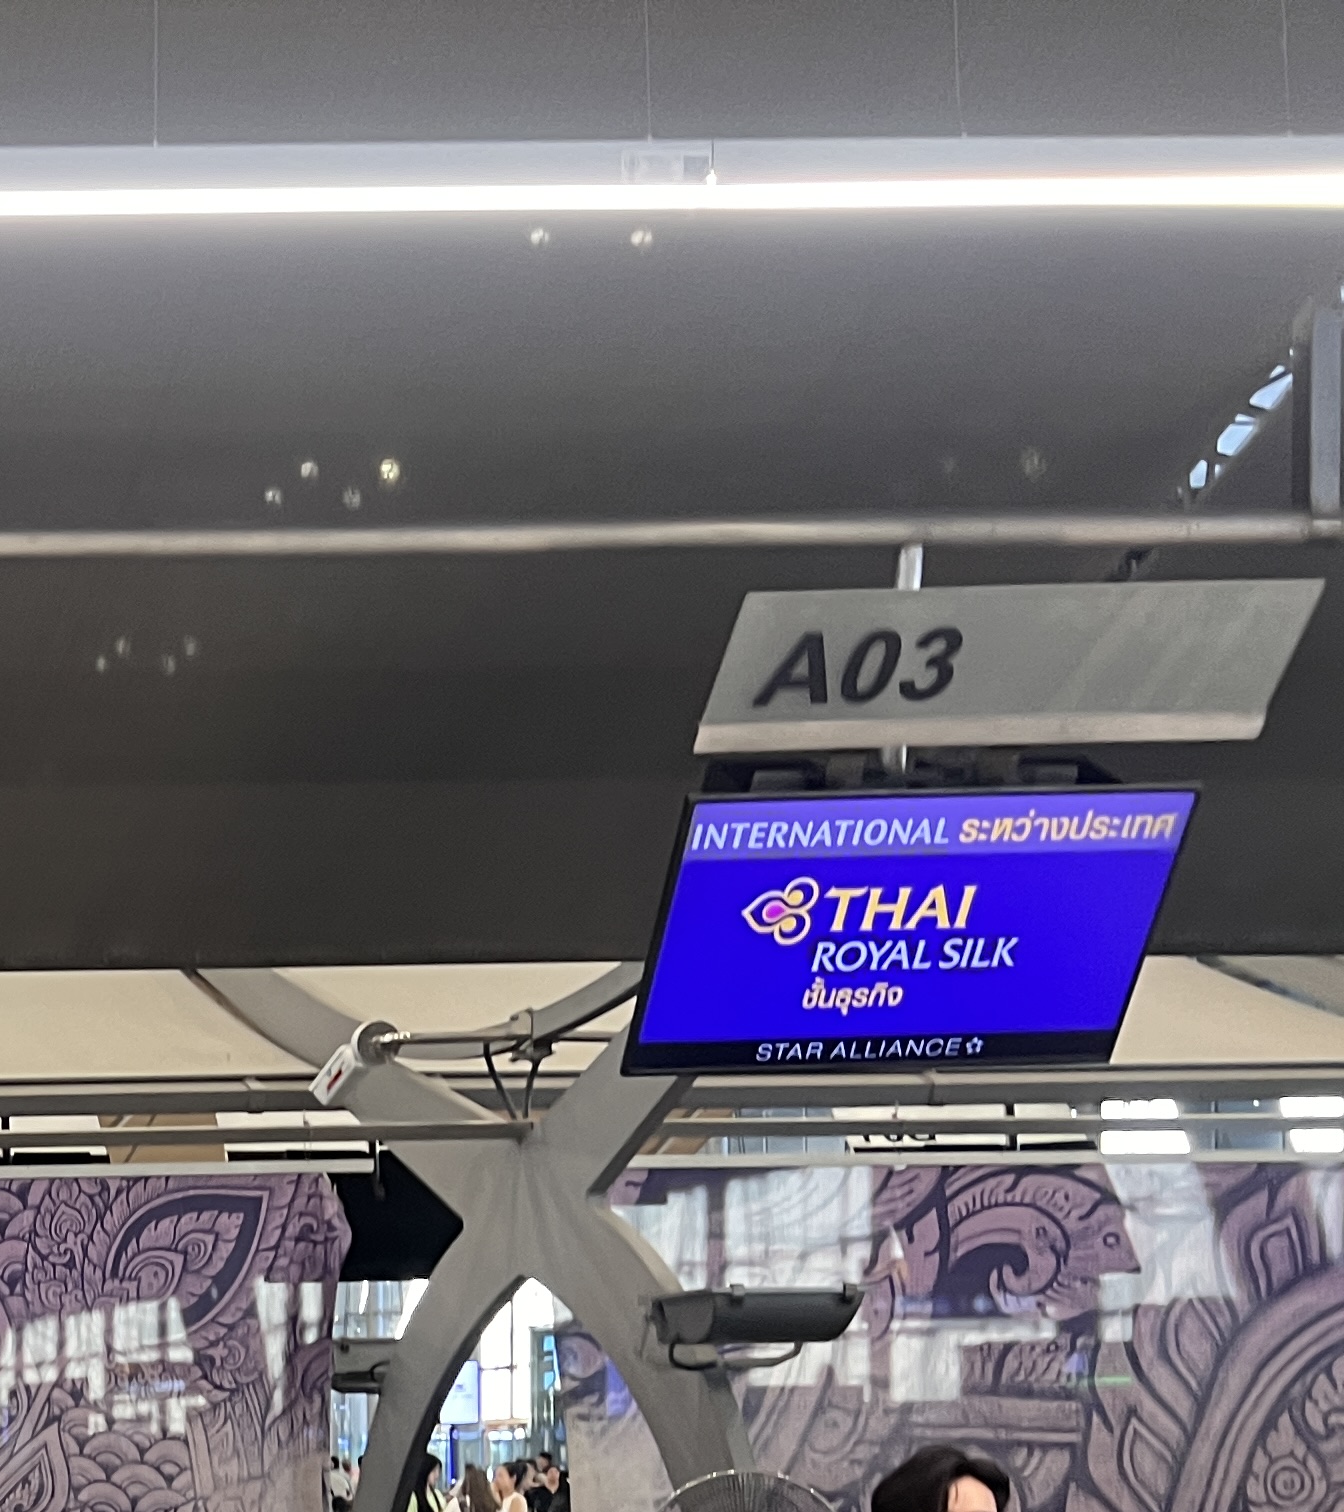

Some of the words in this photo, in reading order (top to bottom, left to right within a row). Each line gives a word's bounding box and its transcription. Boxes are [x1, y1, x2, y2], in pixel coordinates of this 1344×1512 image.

[753, 626, 964, 708] A03
[691, 817, 950, 851] INTERNATIONAL
[959, 809, 1179, 843] ระหว่างประเทศ
[824, 884, 978, 933] THAI
[811, 939, 932, 973] ROYAL
[938, 936, 1020, 971] SILK
[802, 976, 904, 1016] ชั้นธุรกิจ
[756, 1041, 824, 1061] STAR
[830, 1037, 962, 1061] ALLIANCE
